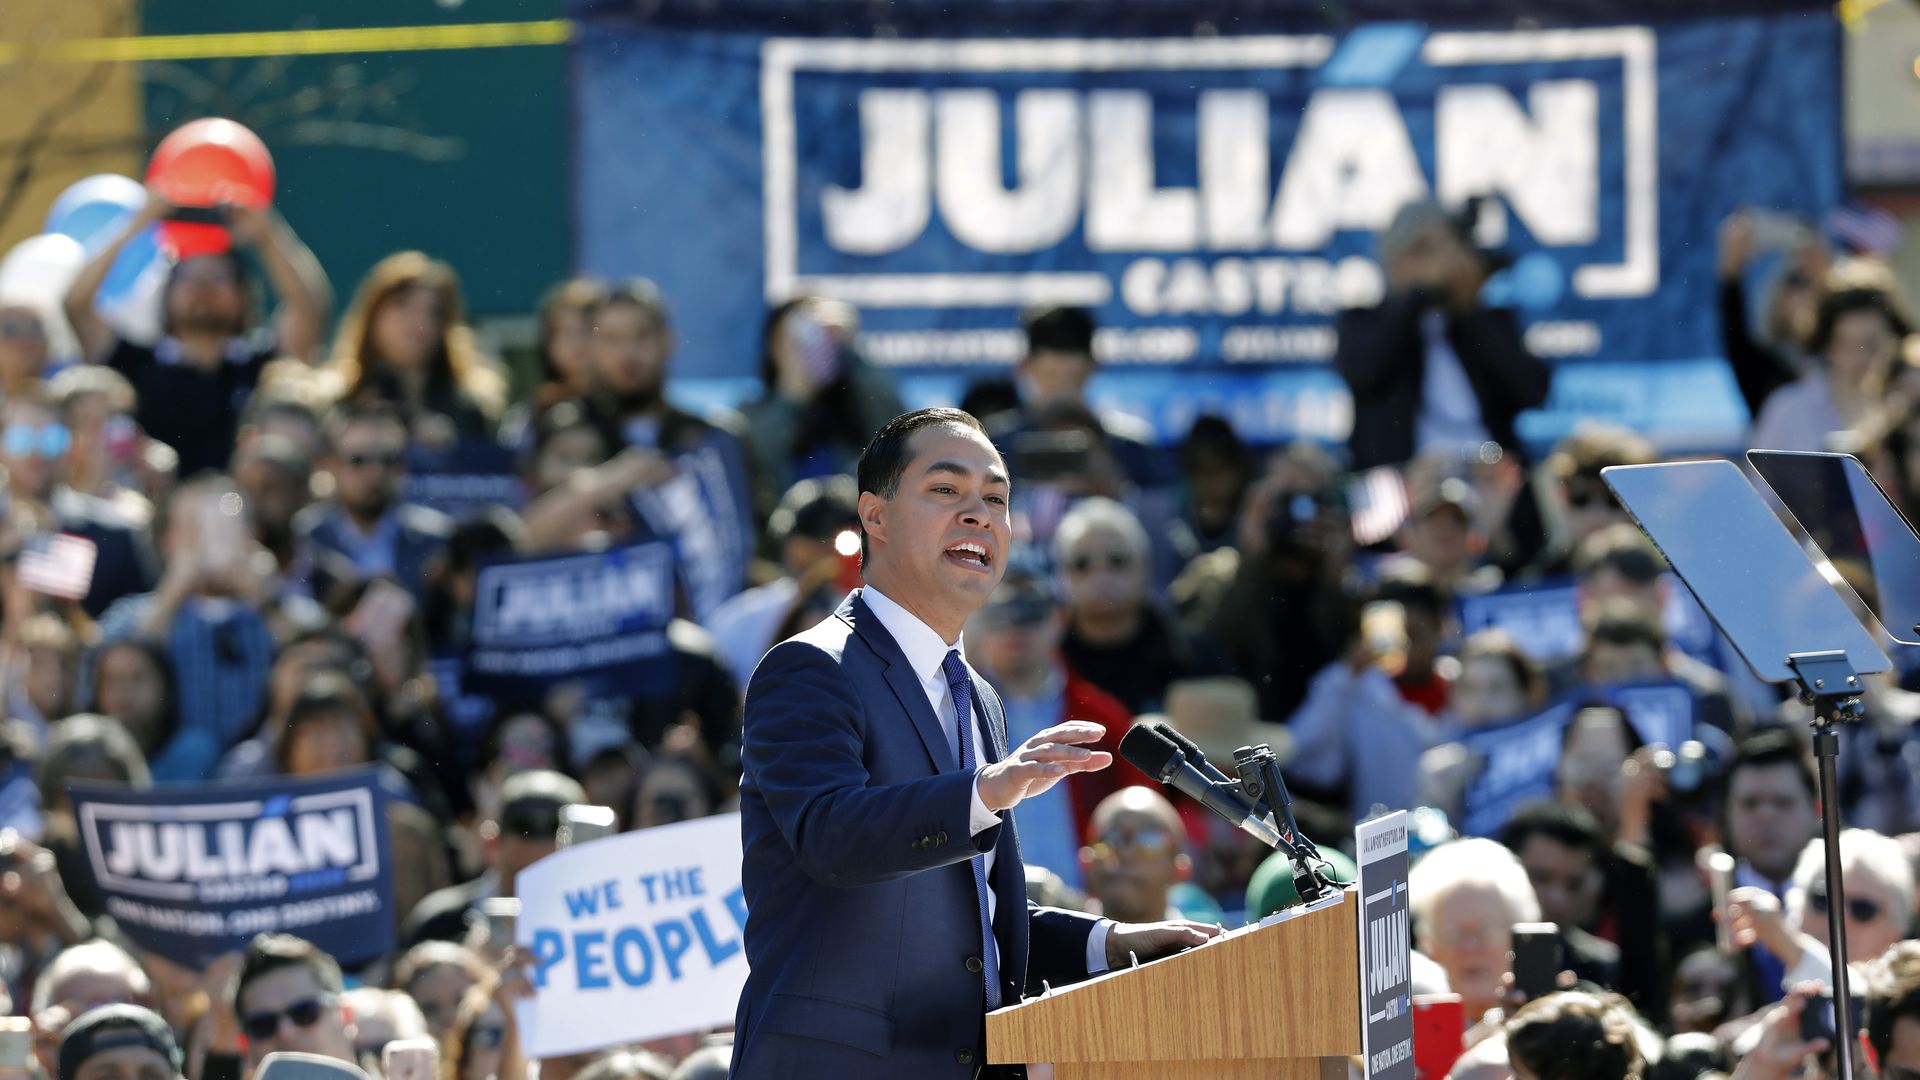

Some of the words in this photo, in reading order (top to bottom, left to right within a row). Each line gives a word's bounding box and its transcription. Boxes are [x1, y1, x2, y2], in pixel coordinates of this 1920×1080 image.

[1122, 256, 1386, 317] CASTRO
[564, 879, 621, 920] WE
[639, 866, 706, 904] THE
